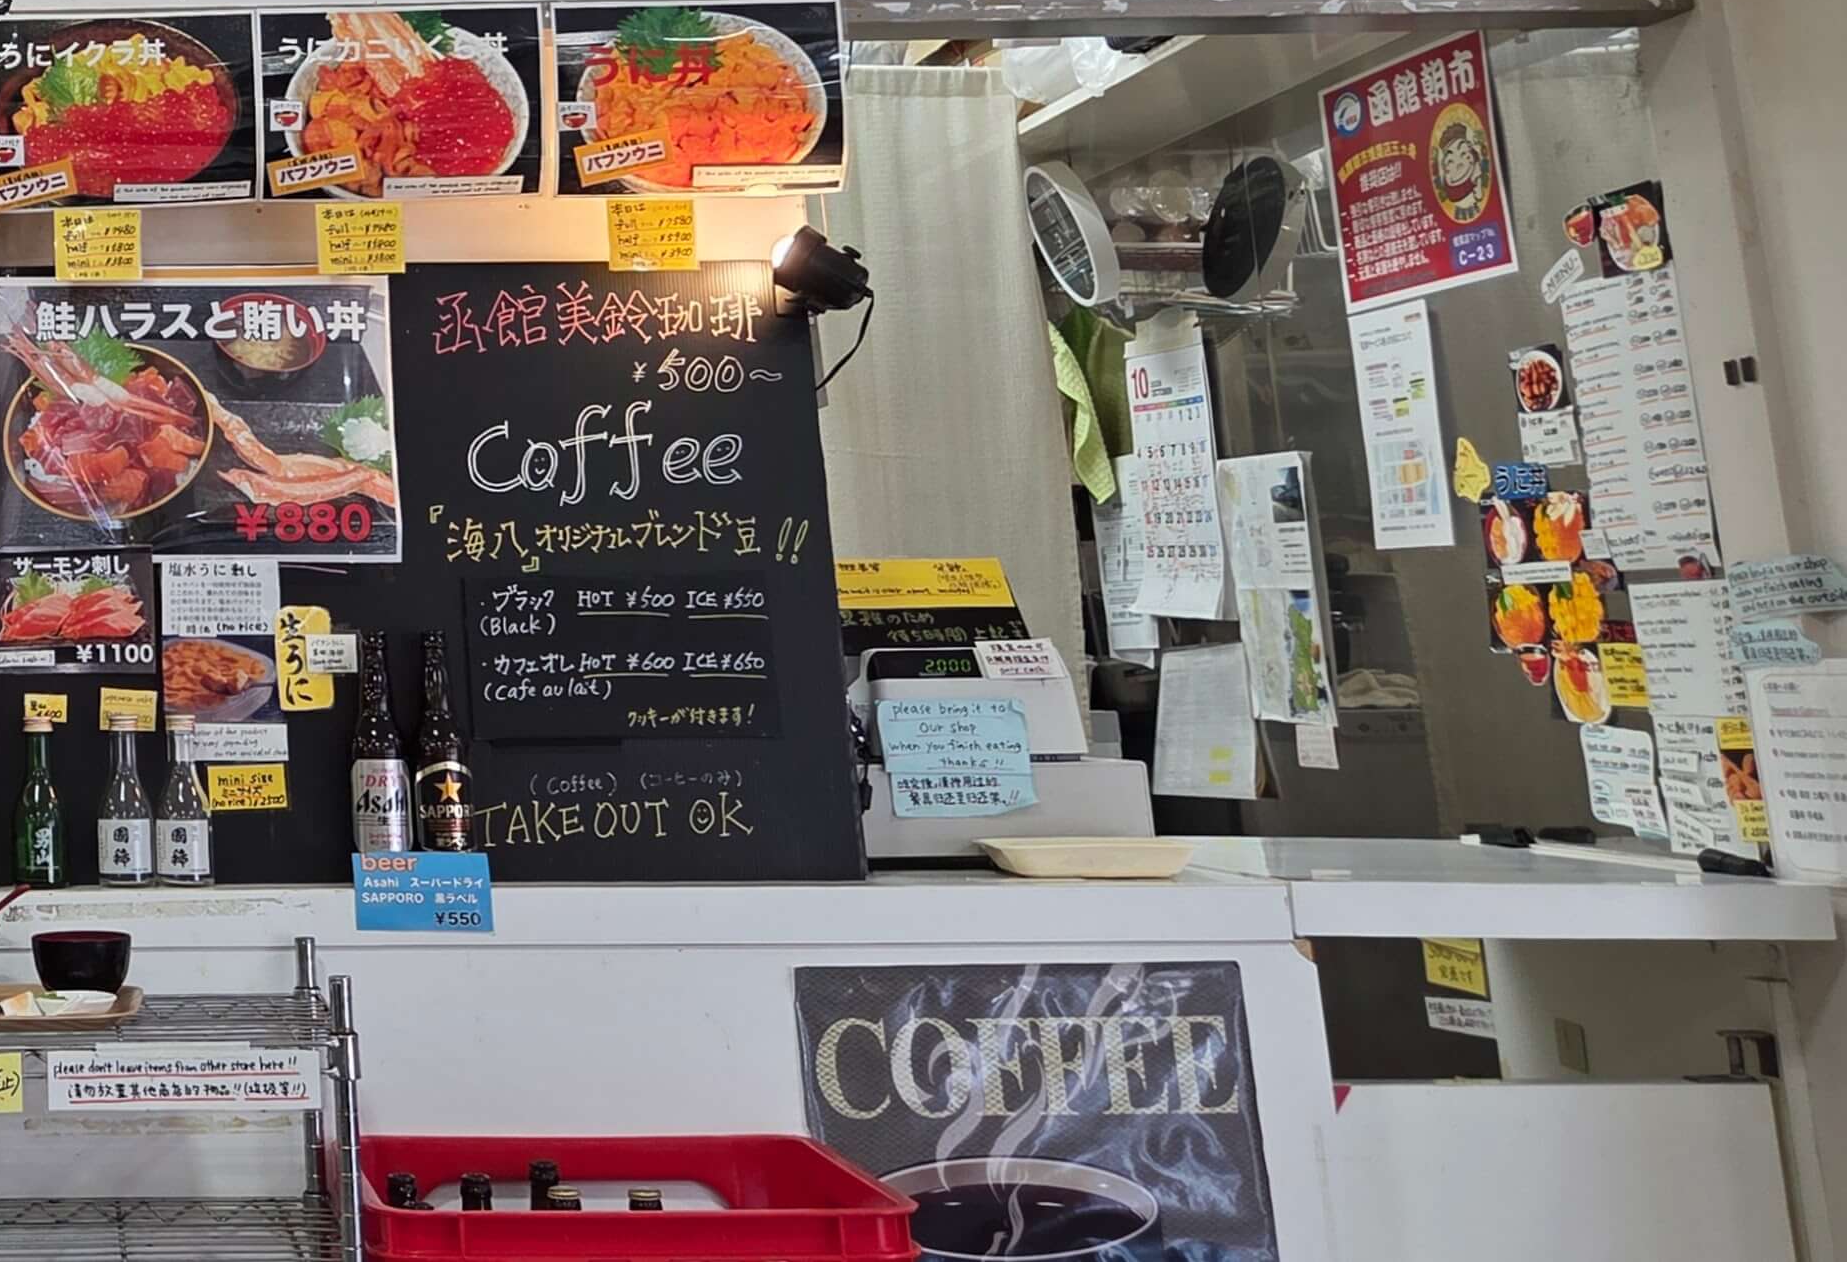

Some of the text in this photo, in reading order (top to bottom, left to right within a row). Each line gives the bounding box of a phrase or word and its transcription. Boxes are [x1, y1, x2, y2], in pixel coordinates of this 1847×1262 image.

[585, 44, 719, 86] うに丼
[1367, 49, 1475, 127] 函館朝市
[587, 143, 664, 171] バフンウニ
[280, 158, 355, 184] バフンウニ
[1458, 243, 1495, 265] C-23
[36, 300, 367, 341] 鮭ハラスと賄い丼
[433, 281, 762, 354] 函館美鈴珈琲
[1131, 367, 1150, 399] 10
[467, 400, 742, 506] Coffee
[234, 502, 371, 544] ¥880
[13, 555, 130, 575] サーモン刺し
[577, 592, 613, 608] HOT
[626, 586, 674, 608] ¥500
[686, 591, 717, 607] ICE
[480, 614, 555, 636] (Black)
[76, 644, 153, 663] ¥1100
[579, 654, 615, 672] HOT
[626, 651, 674, 670] ¥600
[682, 652, 718, 671] ICE
[892, 703, 931, 719] please
[939, 702, 968, 716] bring
[991, 704, 1005, 712] to
[950, 722, 976, 735] shop
[889, 743, 920, 751] when
[927, 742, 945, 753] you
[986, 742, 1021, 753] eating
[218, 774, 245, 786] mini
[474, 792, 753, 846] TAKE OUT OK
[361, 854, 417, 871] beer
[363, 878, 482, 888] Asahi スーパードライ
[361, 893, 478, 904] SAPPORO 黒ラベル
[435, 912, 481, 925] ¥550
[259, 1057, 284, 1070] here
[815, 1015, 1239, 1119] COFFEE
